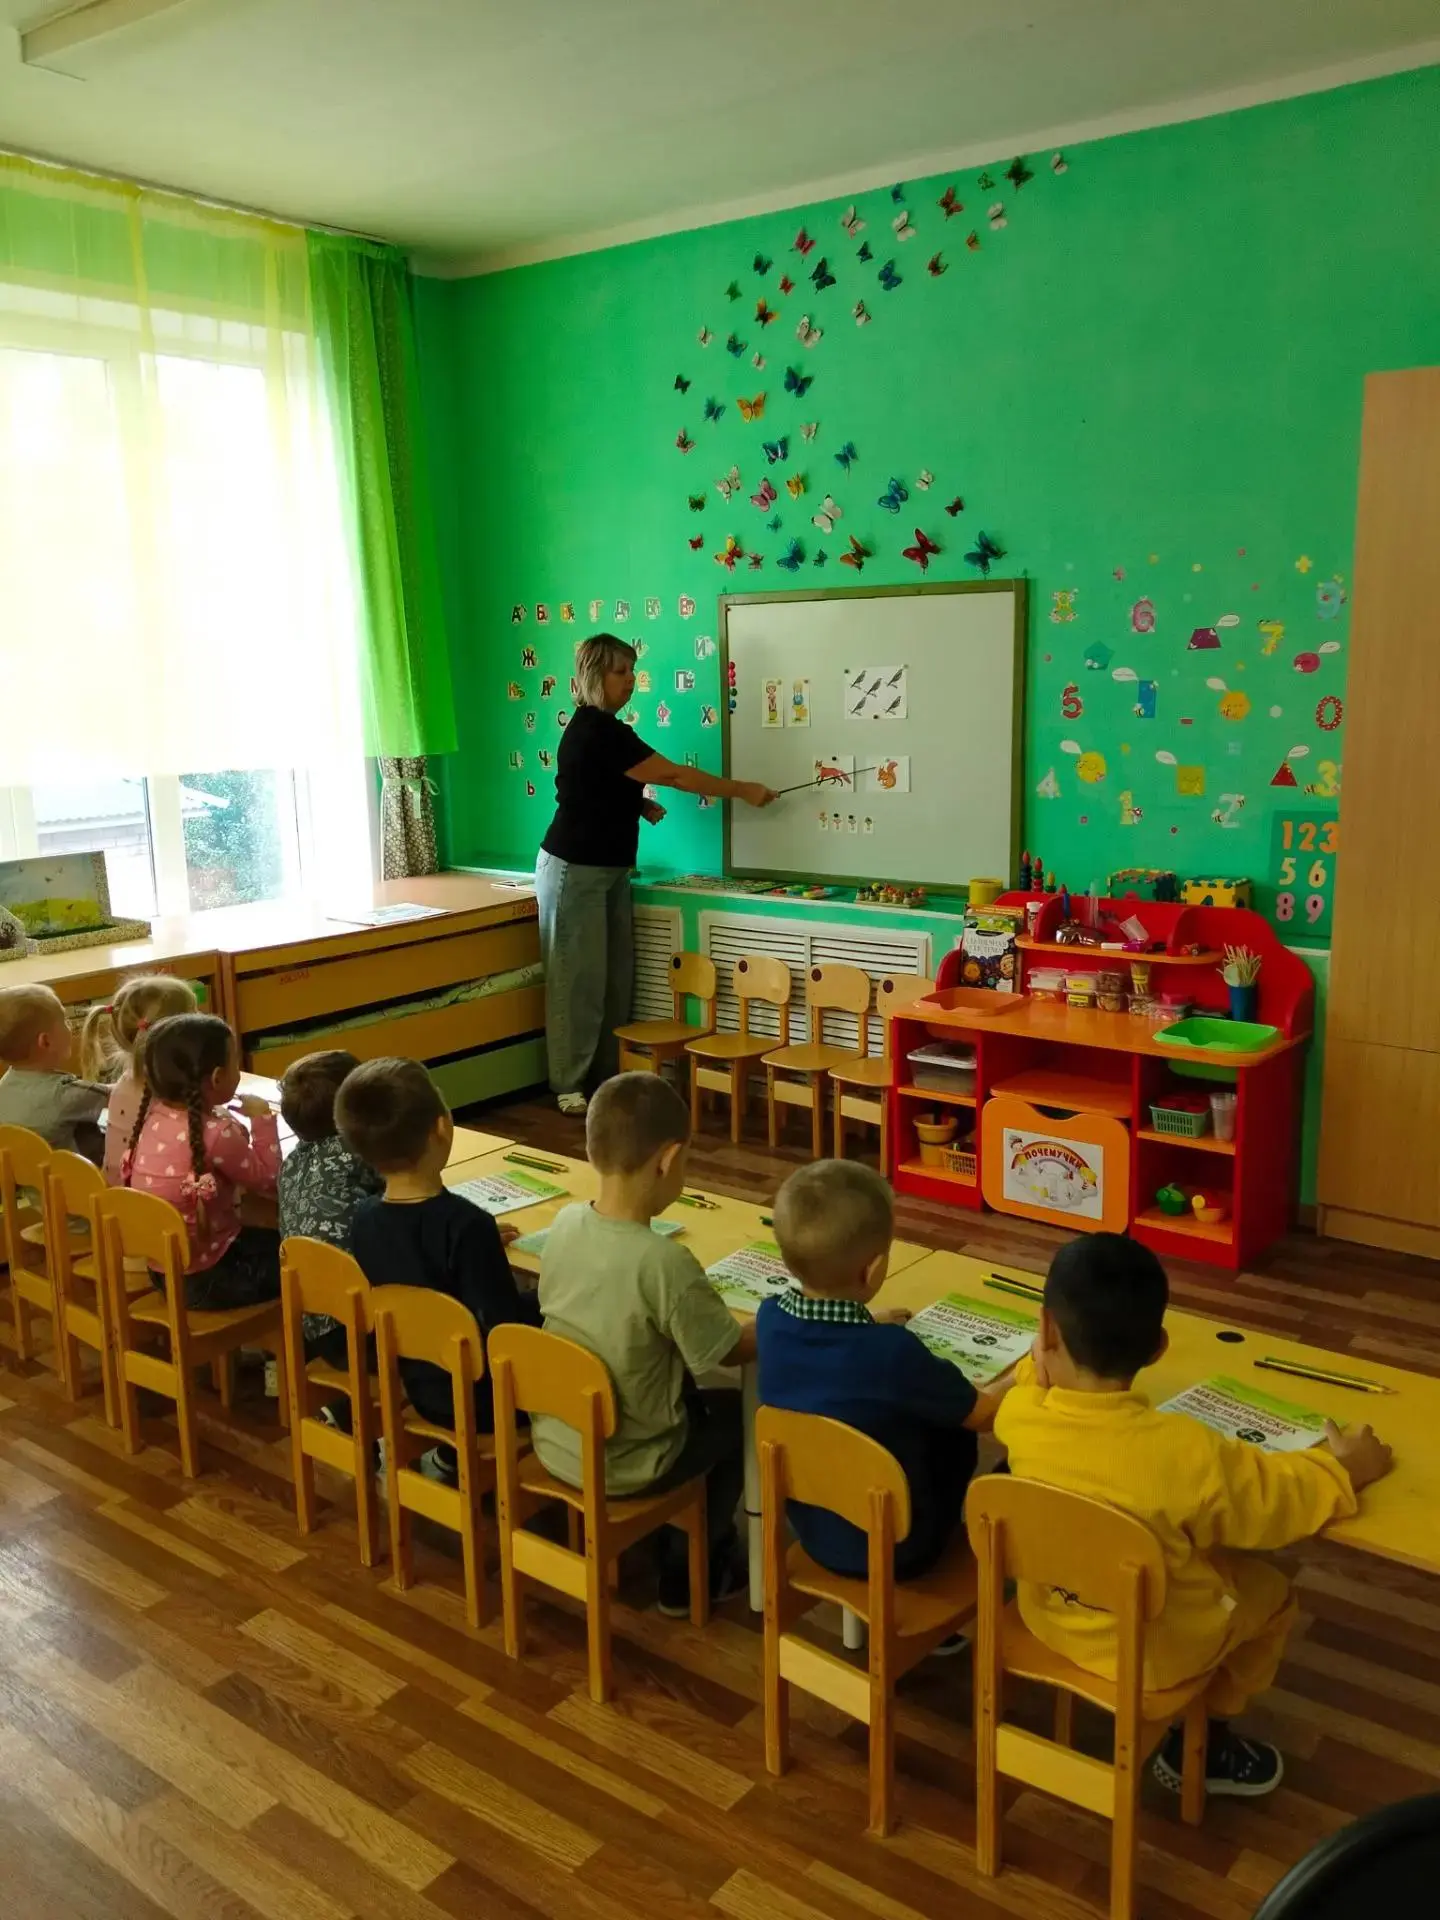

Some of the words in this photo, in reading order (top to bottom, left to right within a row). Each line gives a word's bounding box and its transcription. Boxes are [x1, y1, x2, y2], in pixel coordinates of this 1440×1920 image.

[1132, 599, 1155, 633] 6
[1259, 622, 1285, 656] 7
[1062, 684, 1083, 719] 5
[1036, 767, 1061, 799] 4
[1315, 760, 1340, 797] 3
[1118, 790, 1135, 825] 1
[1217, 794, 1244, 828] 2
[1024, 1148, 1083, 1169] ПОЧЕМУЧКИ
[933, 1304, 1024, 1337] МАТЕМАТИЧЕСКИХ
[1193, 1387, 1298, 1435] МАТЕМАТИЧЕСКИХ
